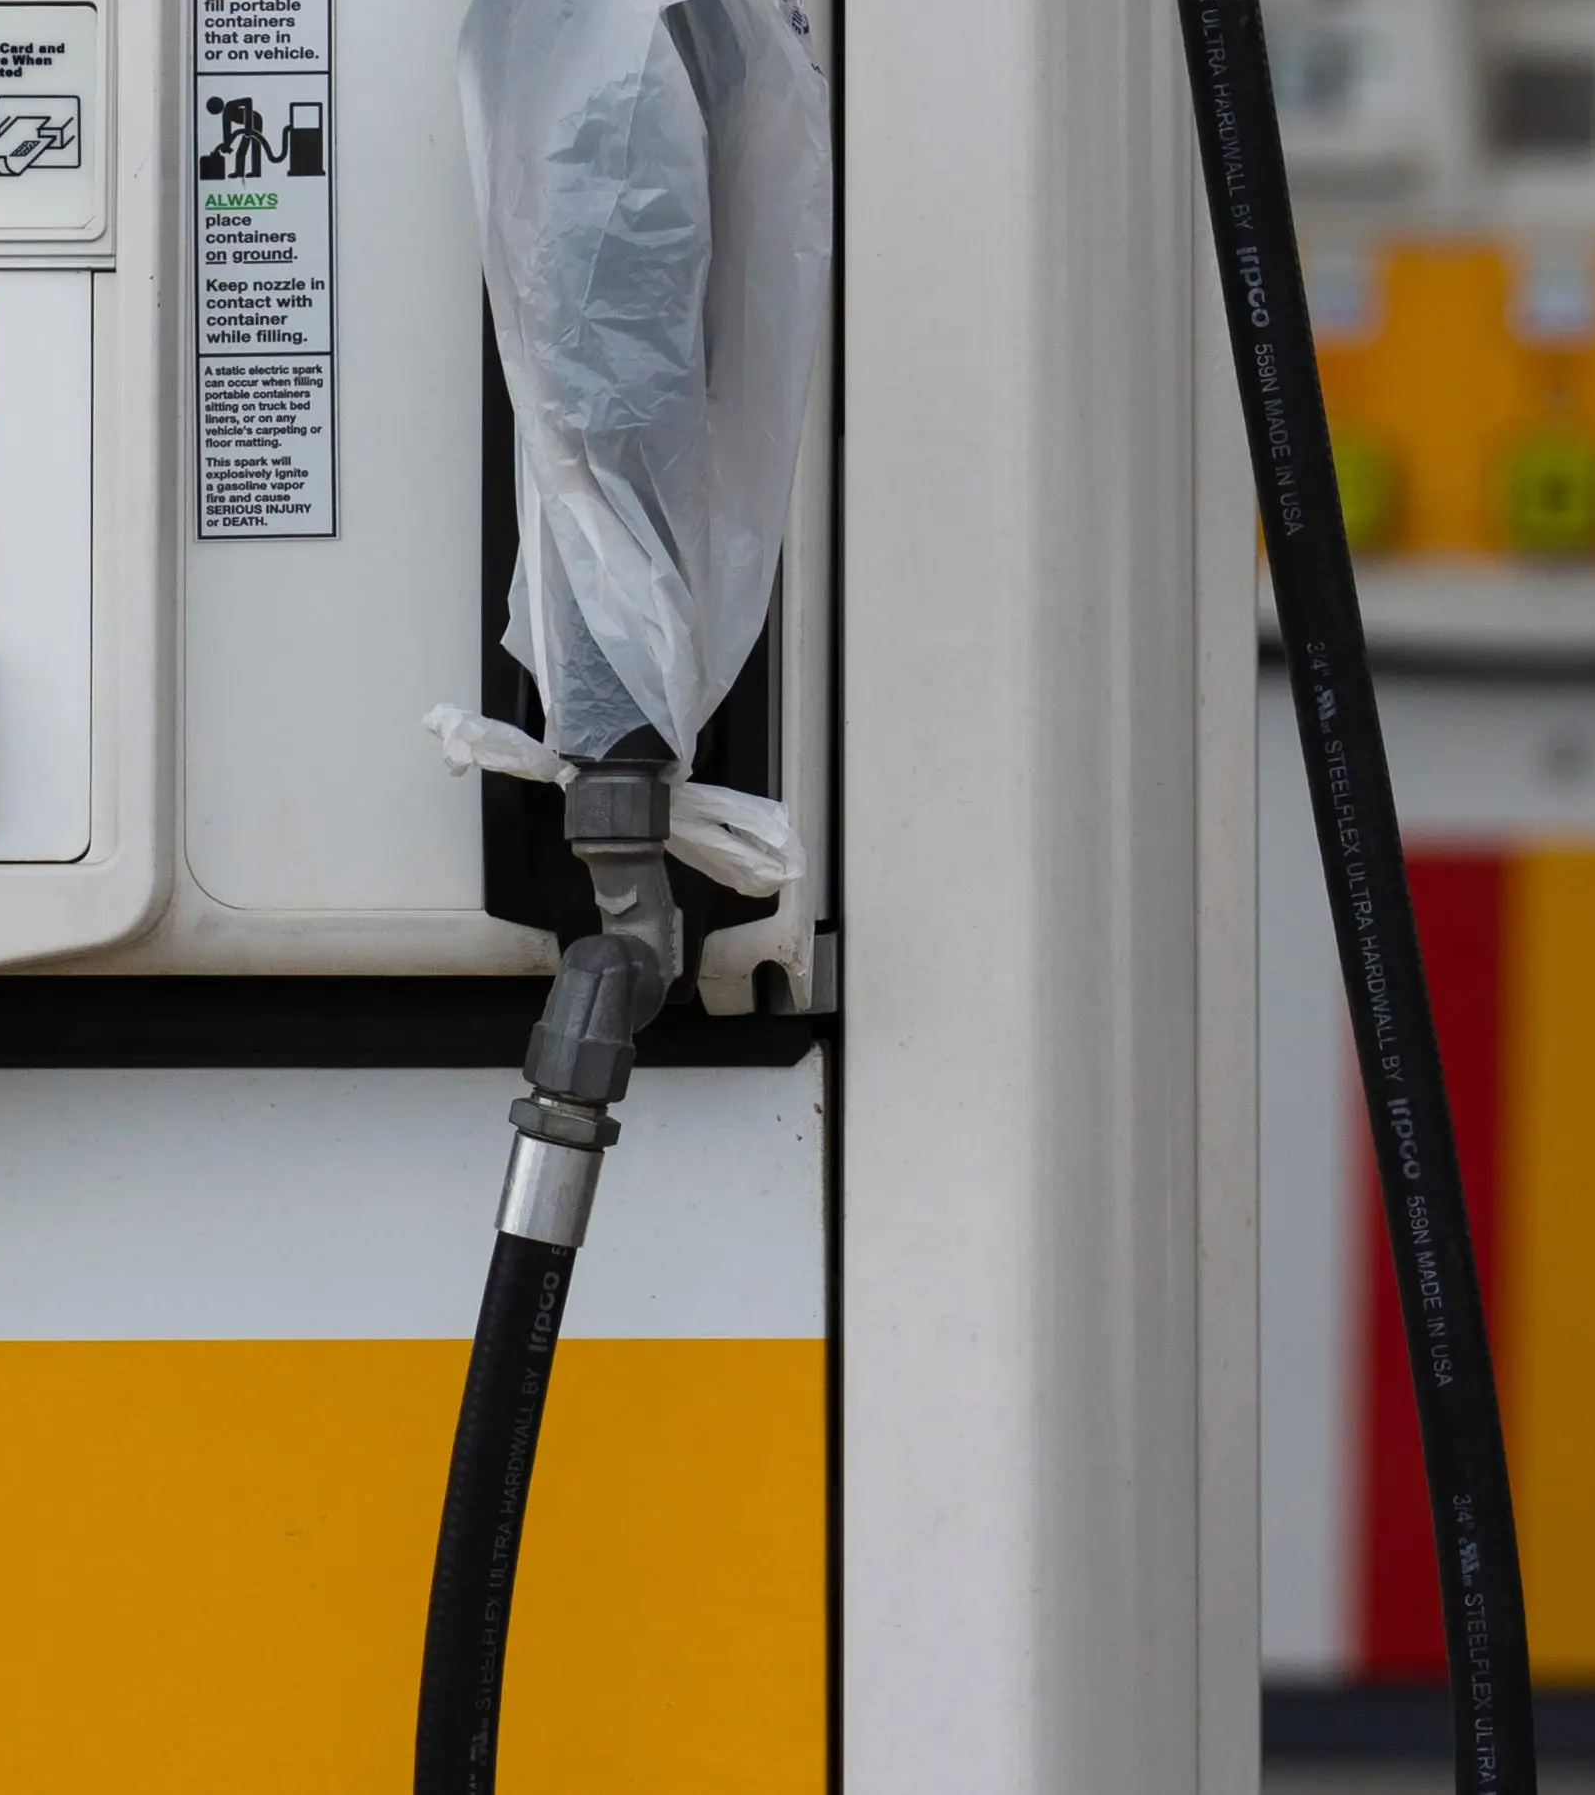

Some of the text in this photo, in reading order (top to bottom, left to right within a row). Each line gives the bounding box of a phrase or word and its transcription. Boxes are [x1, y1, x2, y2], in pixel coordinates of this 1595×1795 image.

[204, 0, 301, 14] fill portable
[205, 15, 295, 28] containers
[205, 31, 291, 44] that are in
[0, 43, 35, 55] Card
[39, 43, 65, 55] and
[205, 46, 319, 60] or on vehicle.
[13, 55, 52, 66] When
[205, 193, 278, 206] ALWAYS
[206, 215, 251, 228] place
[206, 231, 296, 243] containers
[206, 247, 297, 263] on ground.
[206, 278, 325, 294] Keep nozzle in
[206, 295, 312, 309] contact with
[206, 314, 288, 326] container
[206, 329, 308, 344] while filling.
